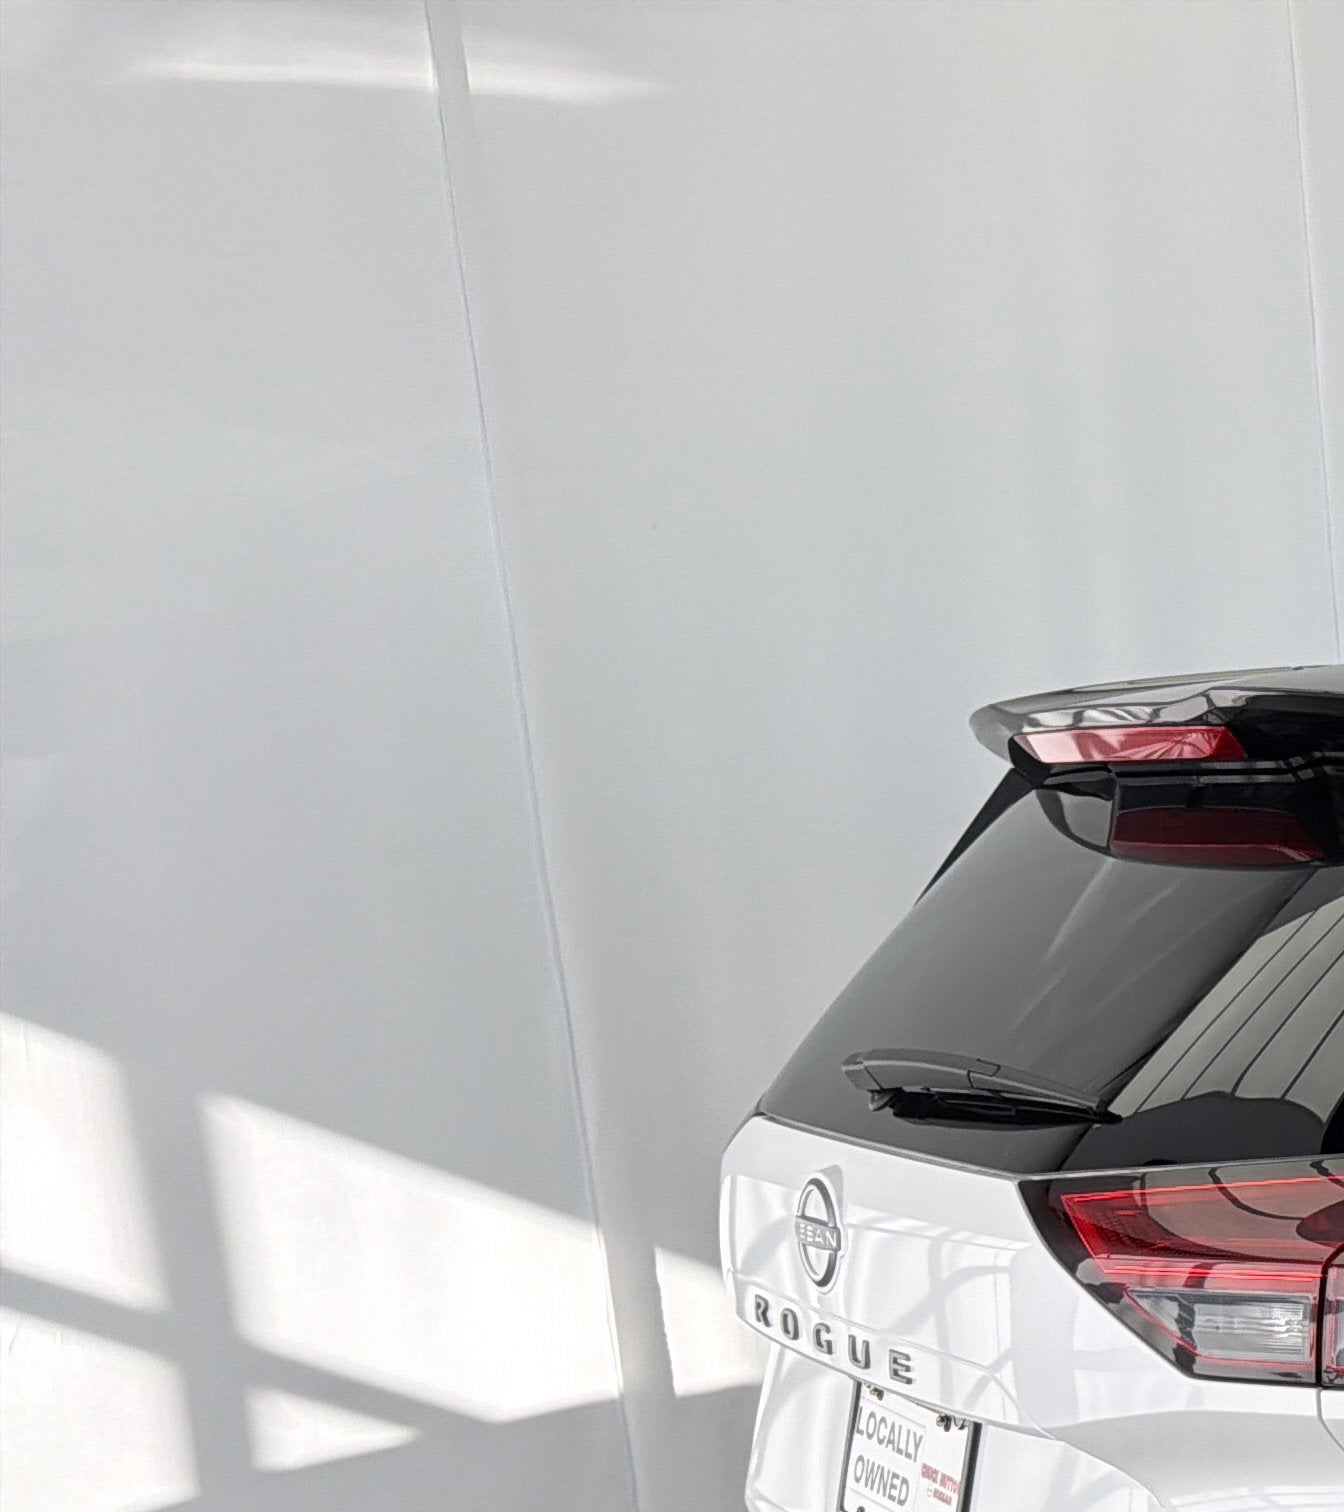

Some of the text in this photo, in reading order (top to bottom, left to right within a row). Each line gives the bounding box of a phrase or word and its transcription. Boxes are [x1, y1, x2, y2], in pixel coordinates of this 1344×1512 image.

[754, 1294, 914, 1385] ROGUE
[856, 1405, 923, 1463] LOCALLY
[853, 1454, 910, 1507] OWNED
